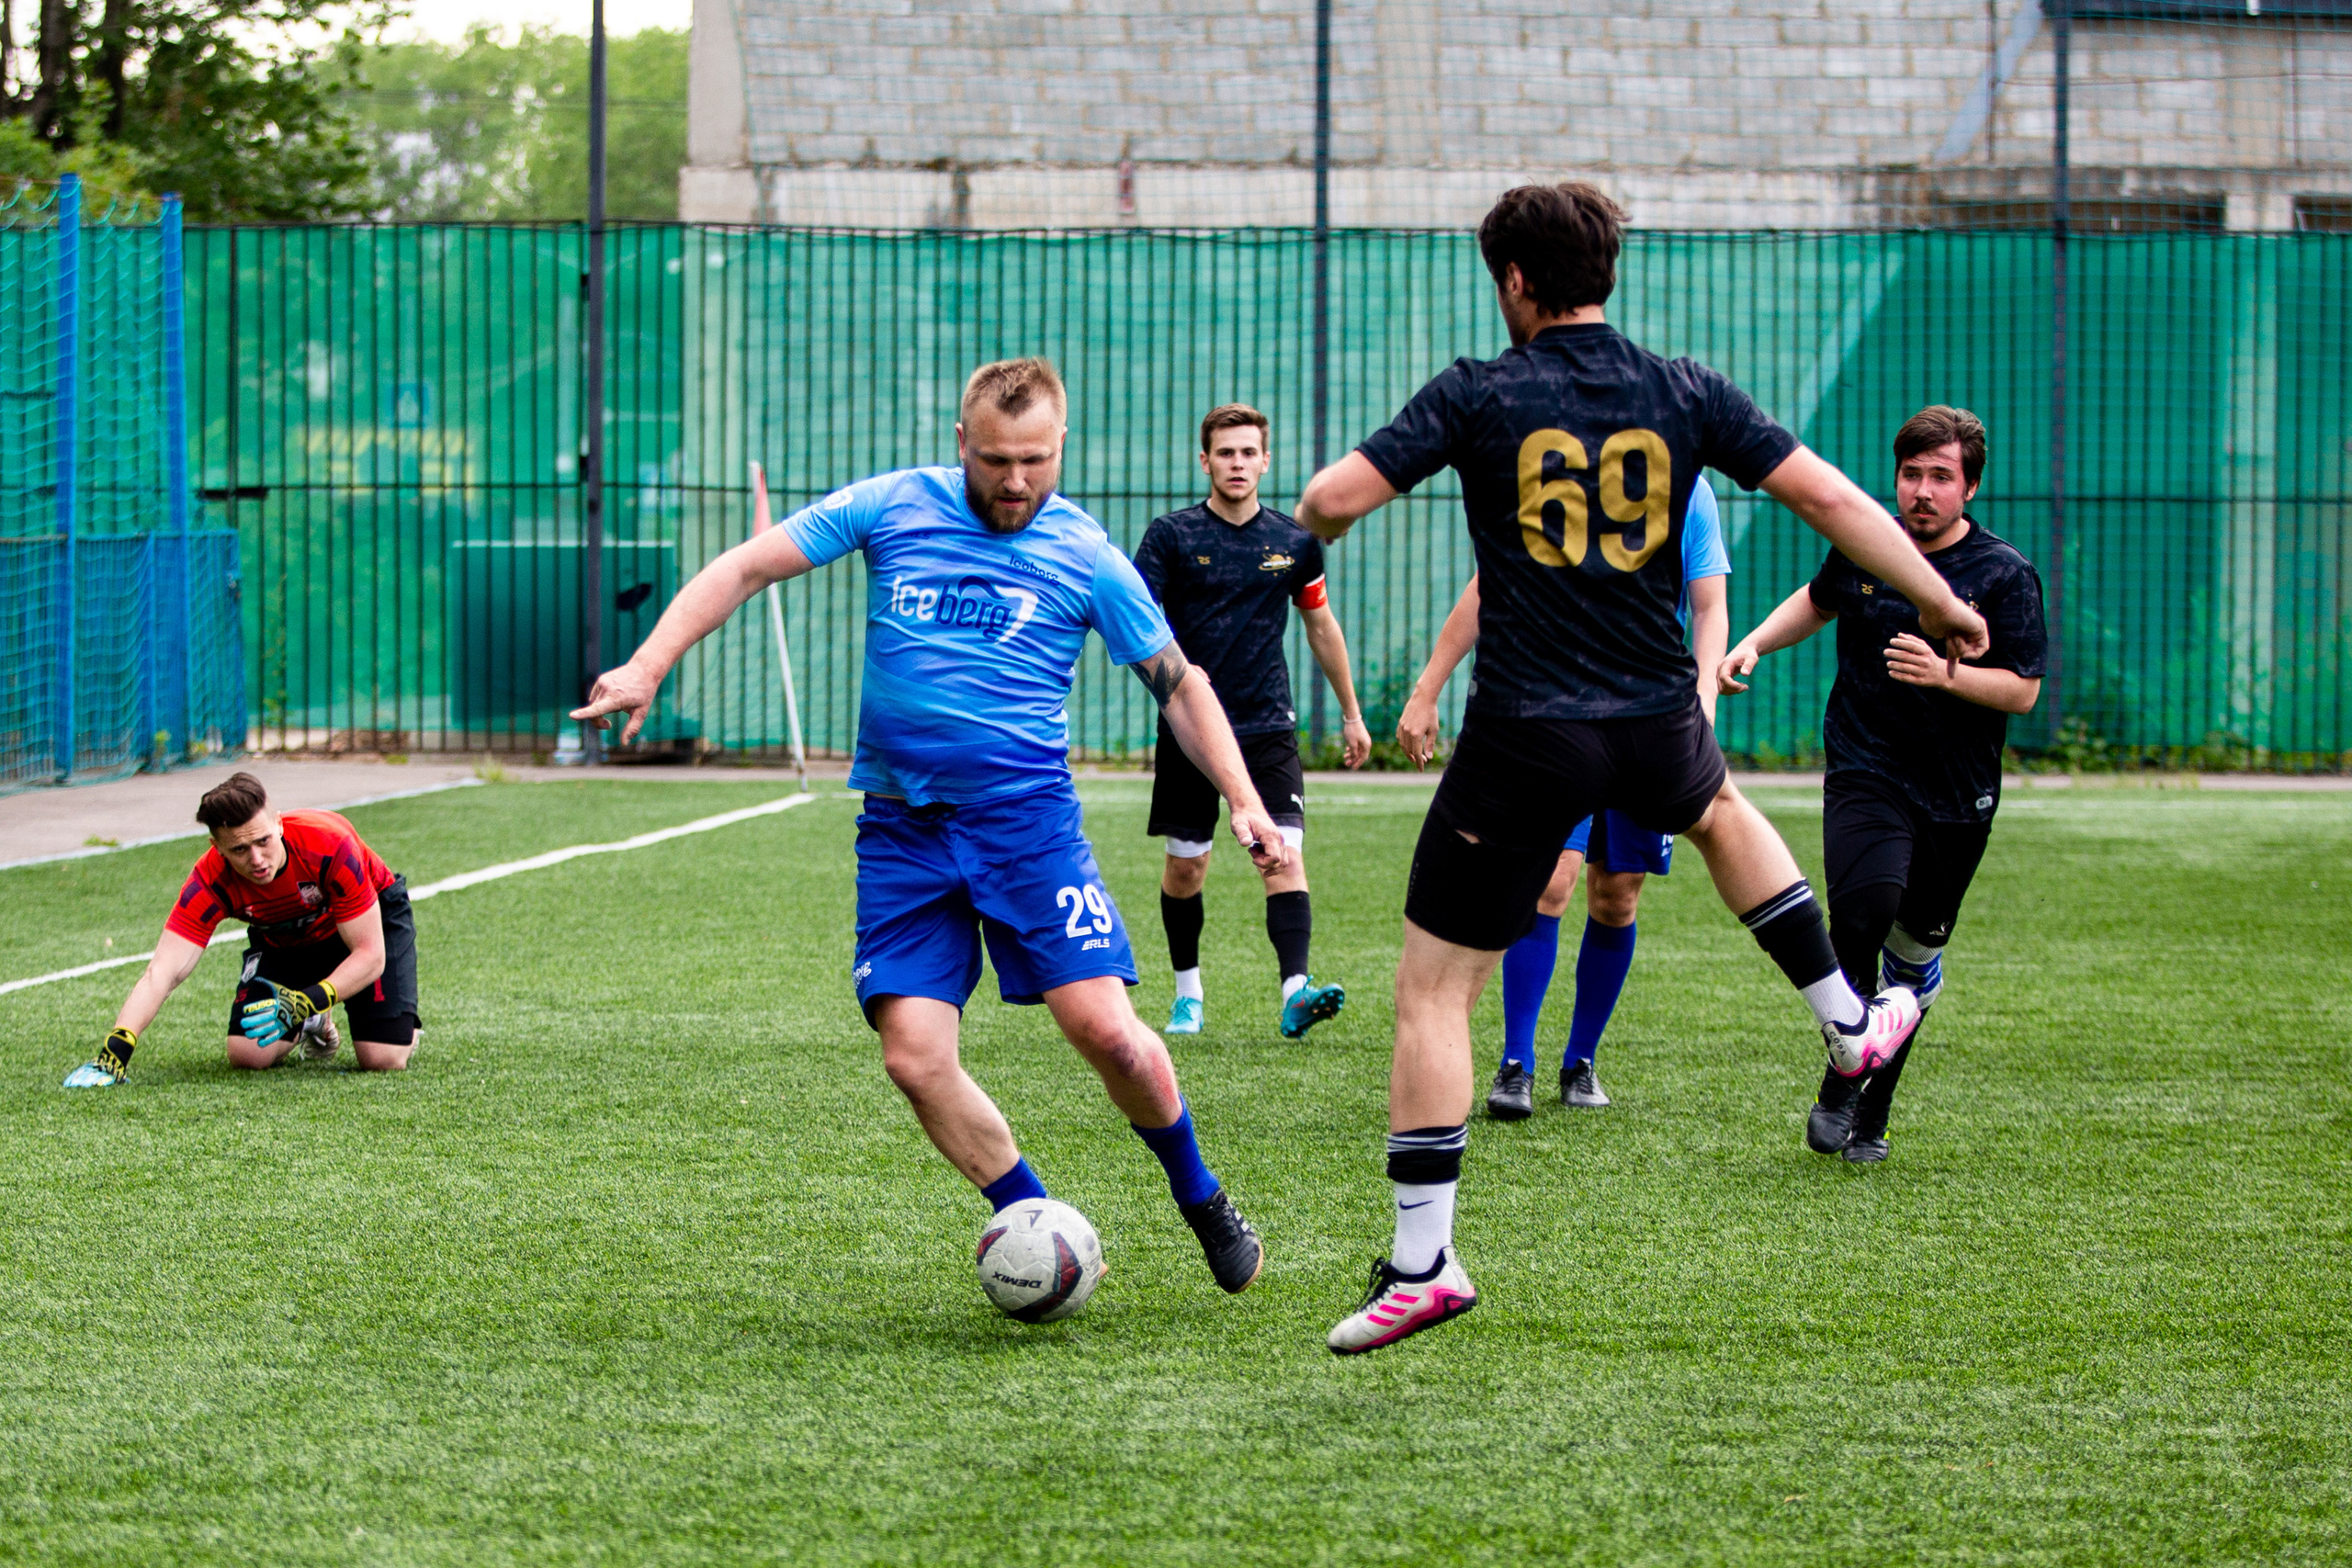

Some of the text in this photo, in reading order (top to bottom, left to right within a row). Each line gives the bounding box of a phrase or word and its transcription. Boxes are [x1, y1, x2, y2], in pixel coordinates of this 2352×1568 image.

[1517, 427, 1672, 572] 69
[891, 575, 1013, 641] Iceberg
[1057, 884, 1113, 938] 29
[1829, 1031, 1847, 1057] COPA
[991, 1270, 1043, 1289] DEMIX
